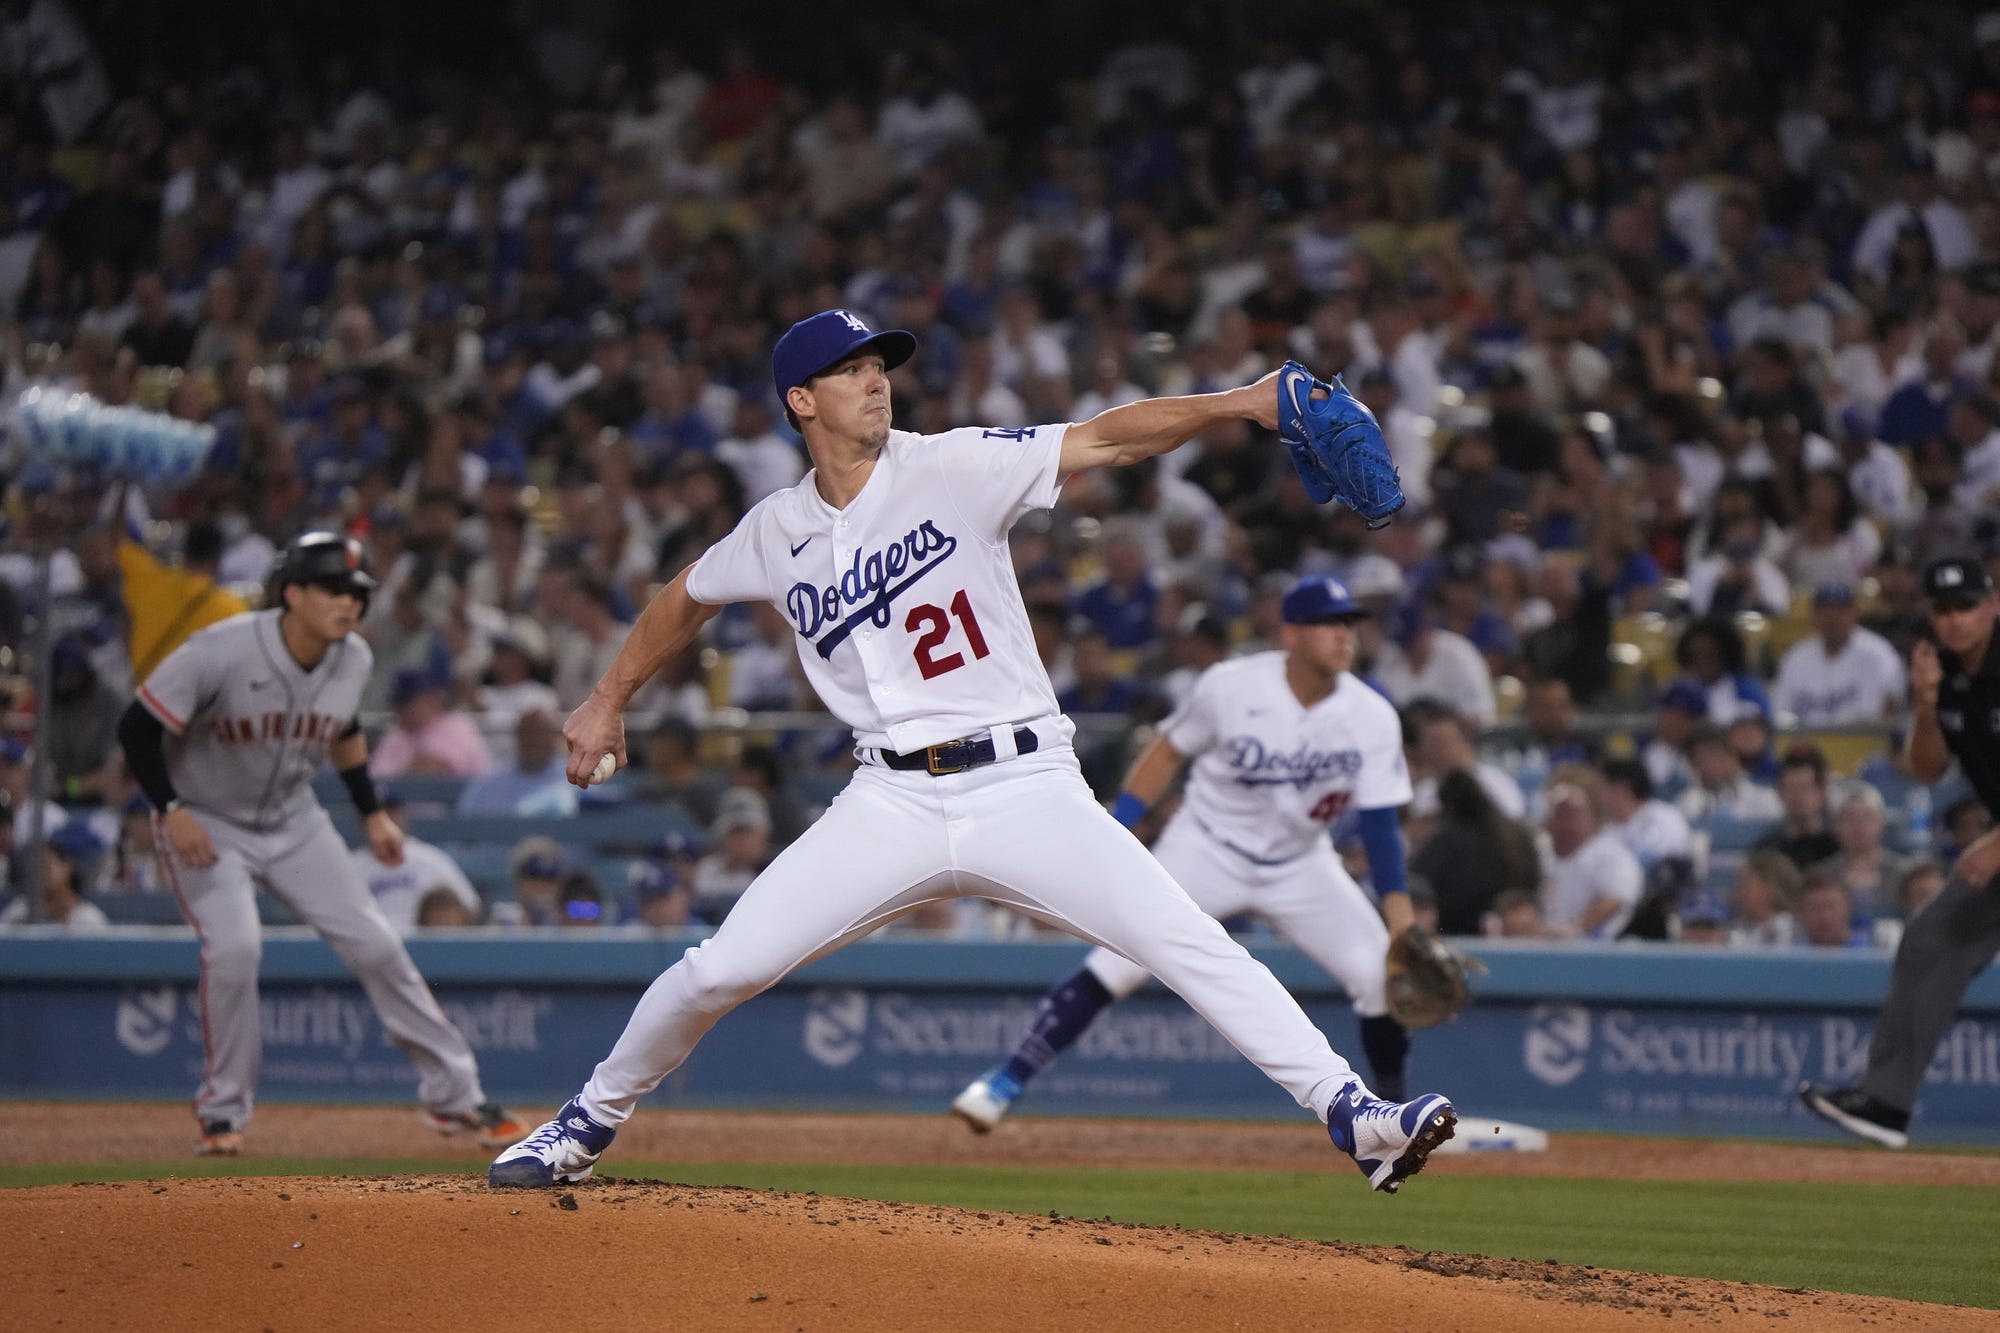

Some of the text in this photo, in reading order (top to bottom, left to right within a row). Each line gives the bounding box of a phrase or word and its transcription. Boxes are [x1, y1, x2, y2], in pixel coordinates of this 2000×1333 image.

[838, 310, 870, 333] LA
[786, 519, 957, 661] Dodgers
[905, 588, 990, 681] 21
[1229, 736, 1363, 789] Dodgers
[877, 995, 1042, 1056] Securi
[1602, 1011, 2000, 1090] Security Beefit
[571, 1116, 590, 1130] NIKE
